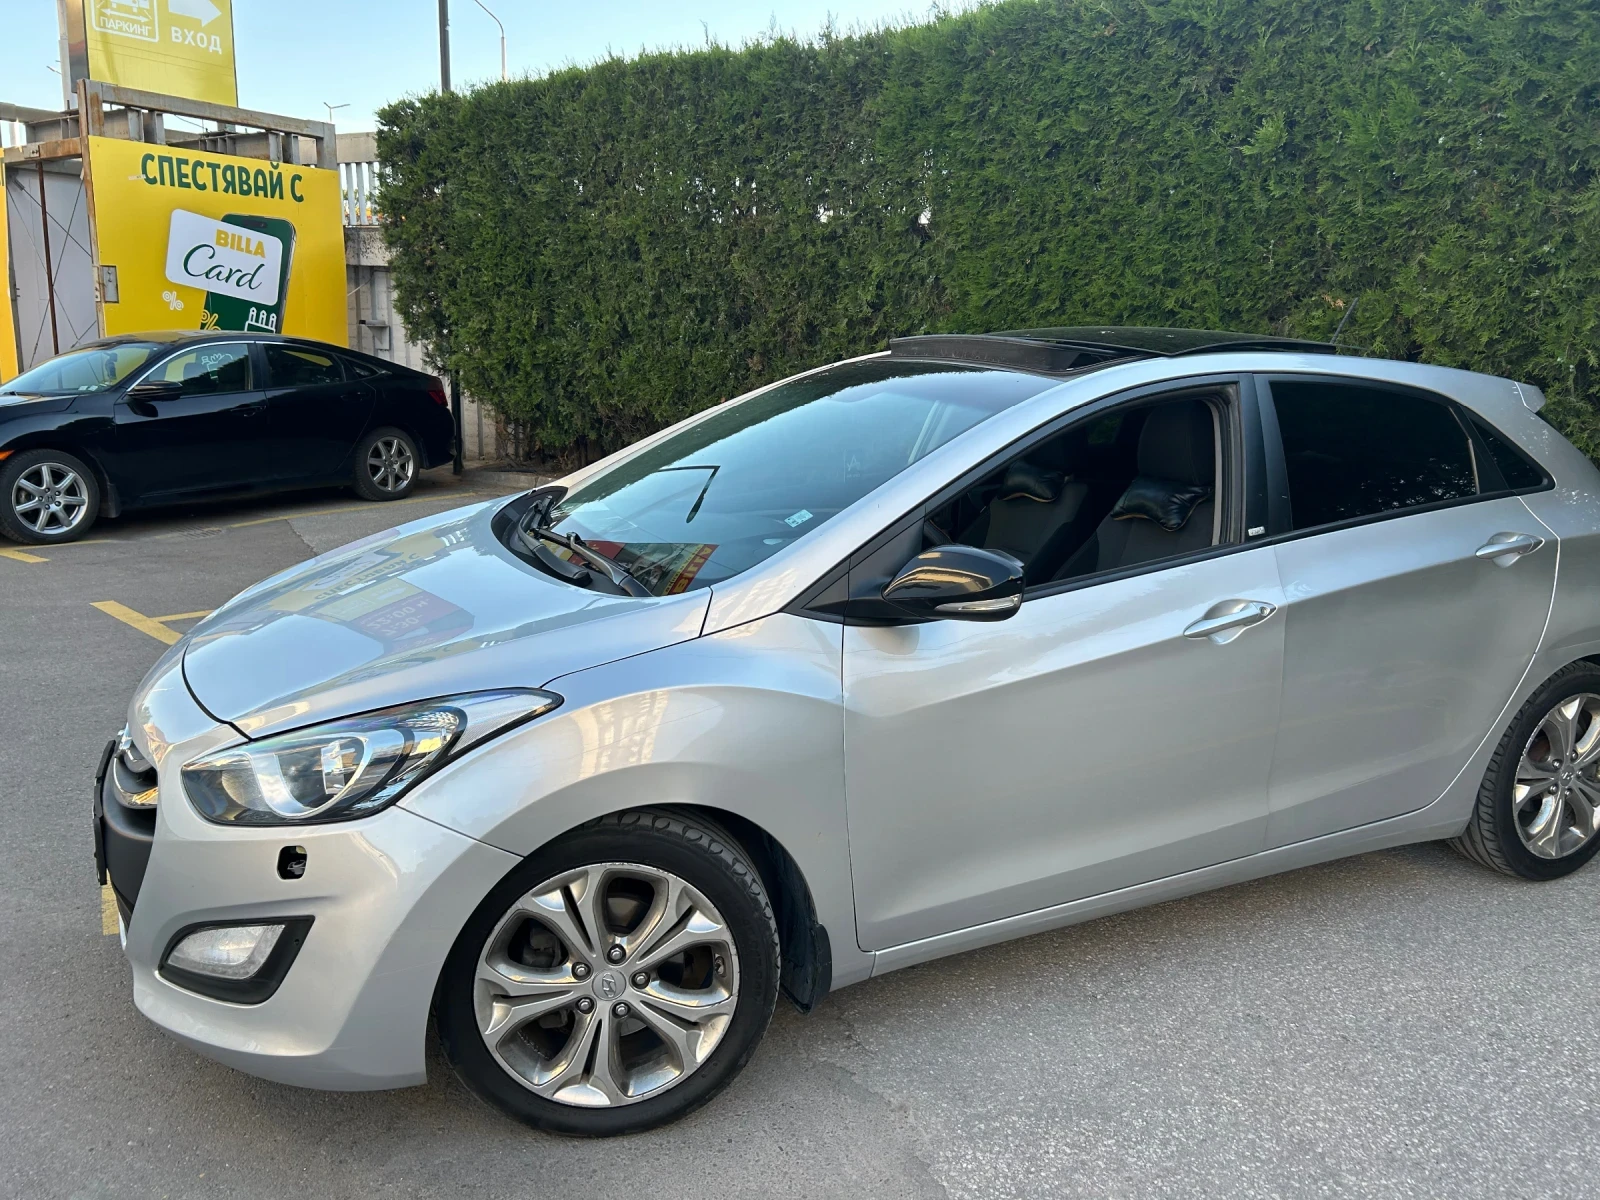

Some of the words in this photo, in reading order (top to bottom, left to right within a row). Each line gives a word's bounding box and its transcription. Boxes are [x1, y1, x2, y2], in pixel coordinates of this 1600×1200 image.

[100, 16, 152, 36] ПАРКИНГ
[170, 26, 222, 54] ВХОД
[141, 153, 284, 200] СПЕСТЯВАЙ
[215, 228, 266, 259] BILLA
[183, 243, 266, 290] Card
